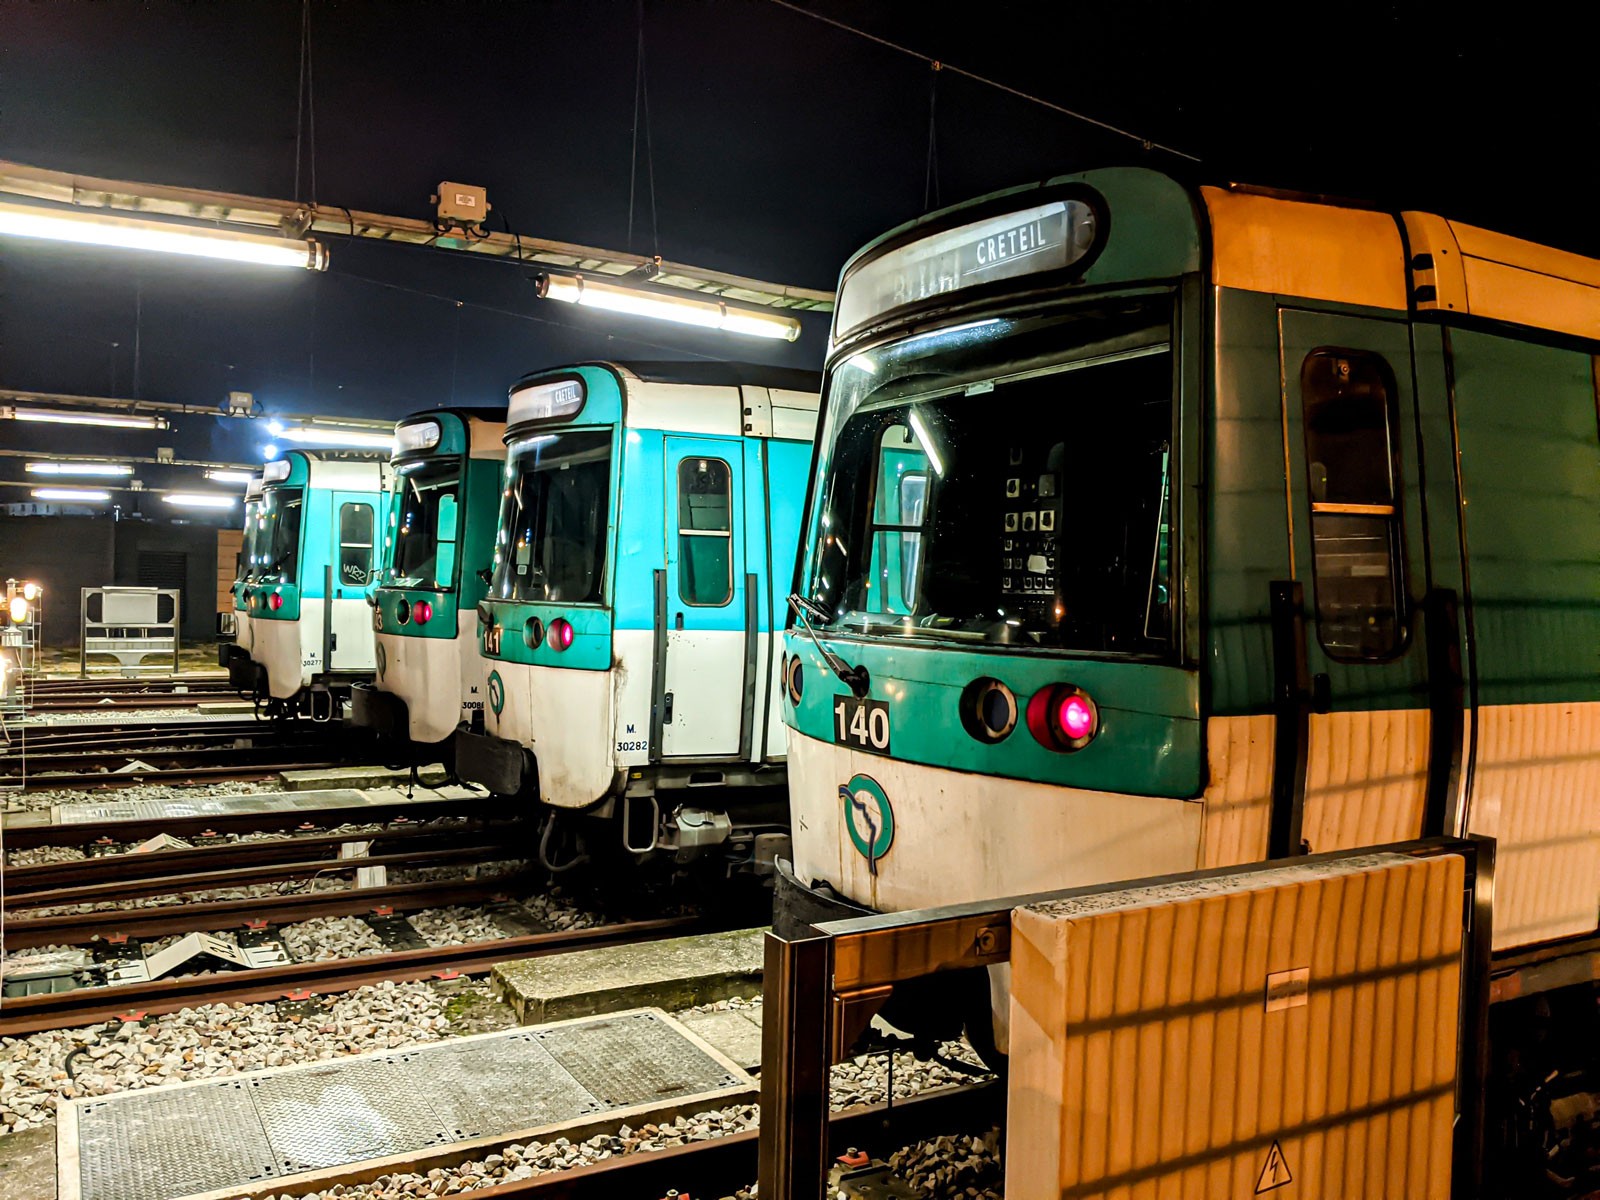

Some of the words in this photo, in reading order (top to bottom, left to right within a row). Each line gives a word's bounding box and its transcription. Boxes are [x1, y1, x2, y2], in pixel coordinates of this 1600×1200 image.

[976, 220, 1046, 265] CRETEIL
[483, 630, 501, 655] 141
[833, 701, 890, 750] 140
[616, 740, 648, 752] 30282
